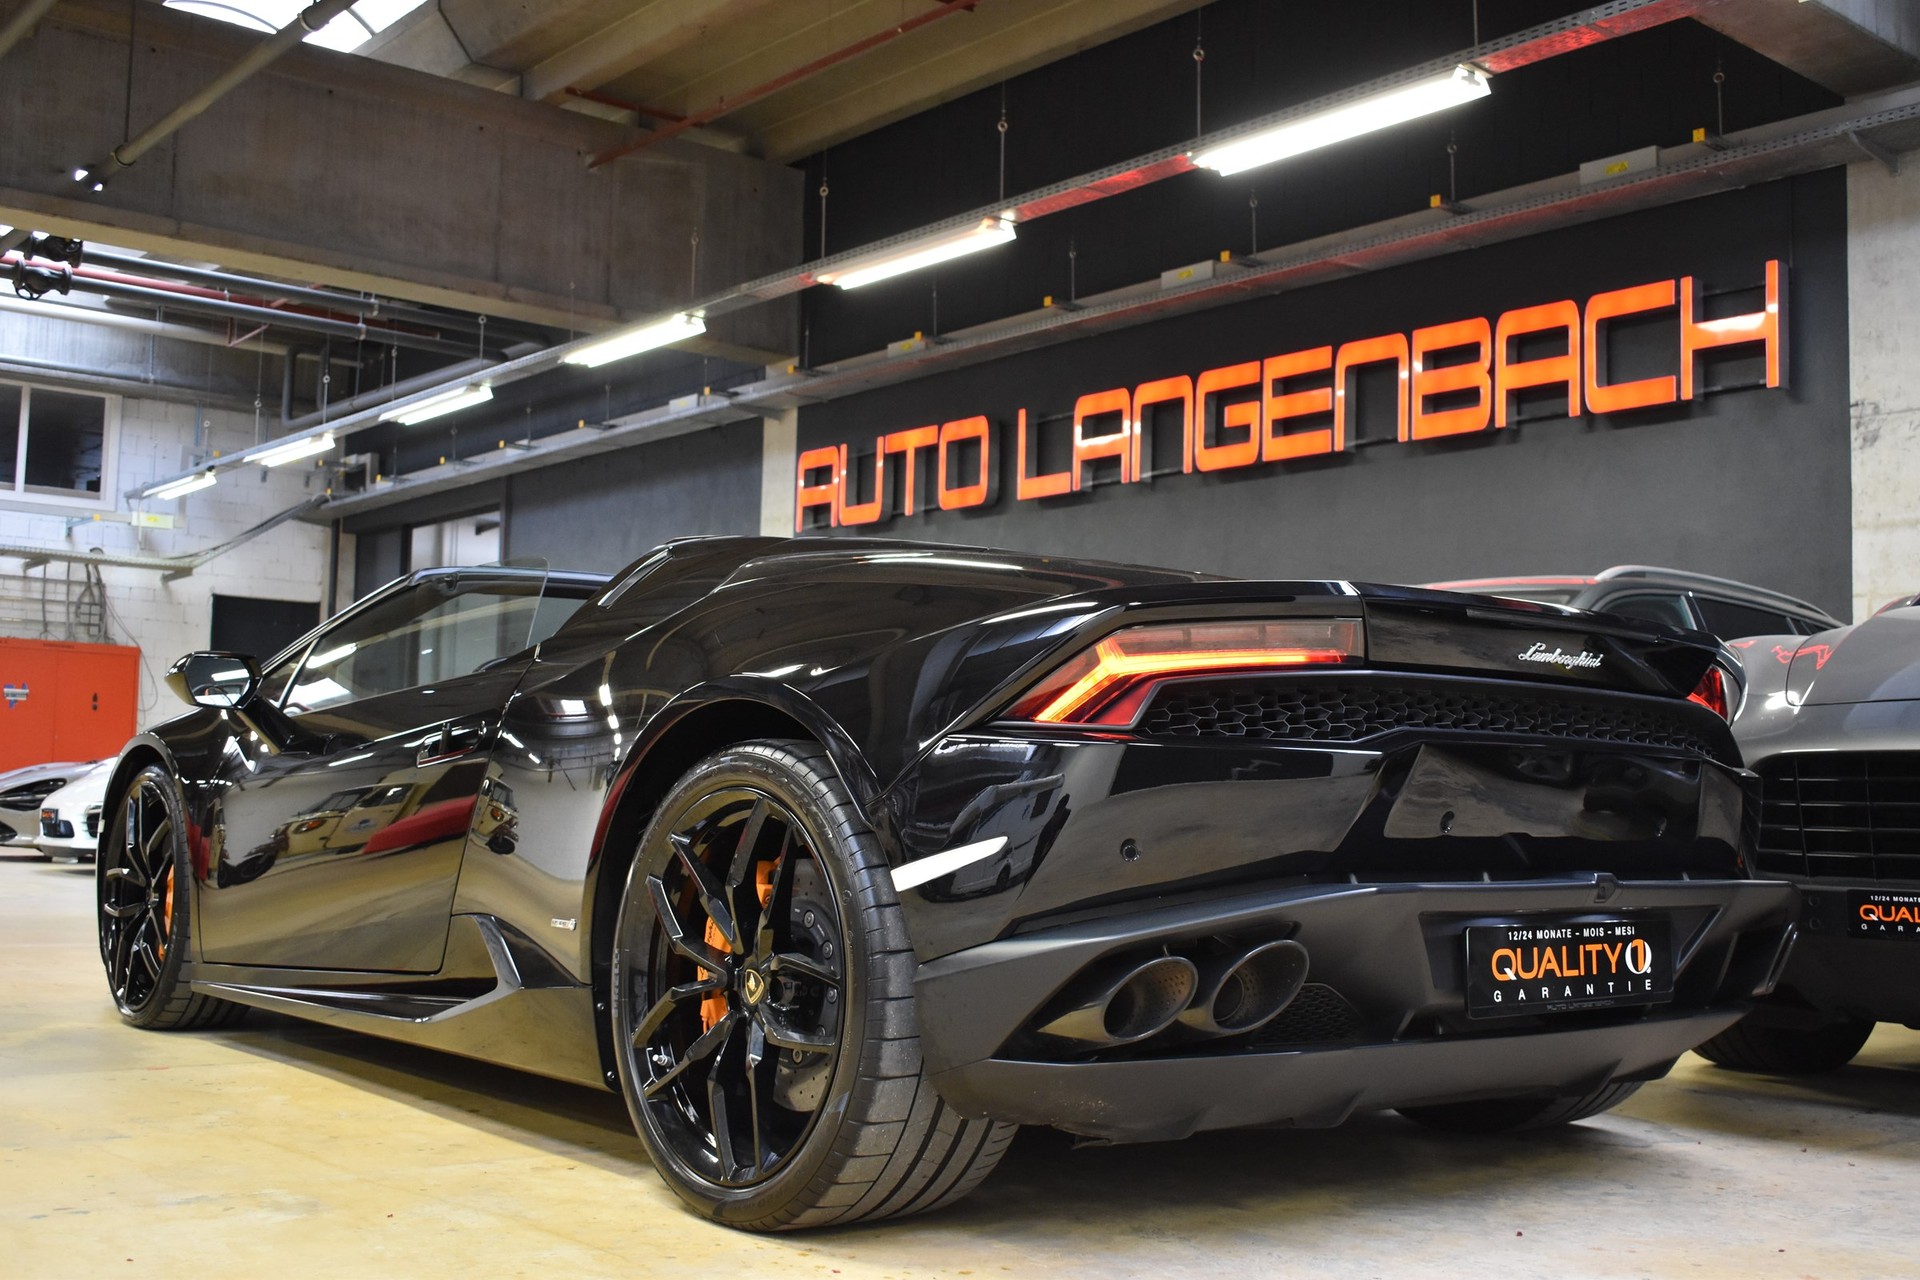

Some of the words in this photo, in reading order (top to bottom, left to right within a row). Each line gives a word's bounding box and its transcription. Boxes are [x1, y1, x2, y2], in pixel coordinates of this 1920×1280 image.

[795, 414, 989, 534] AUTO
[1016, 258, 1780, 501] LANGENBACH
[1518, 641, 1604, 670] Lamborghini
[1508, 930, 1533, 941] 12/24
[1536, 928, 1572, 940] MONATE
[1583, 927, 1605, 937] MOIS
[1615, 926, 1635, 936] MESI
[1491, 942, 1623, 981] QUALITY
[1493, 979, 1652, 1003] GARANTIE
